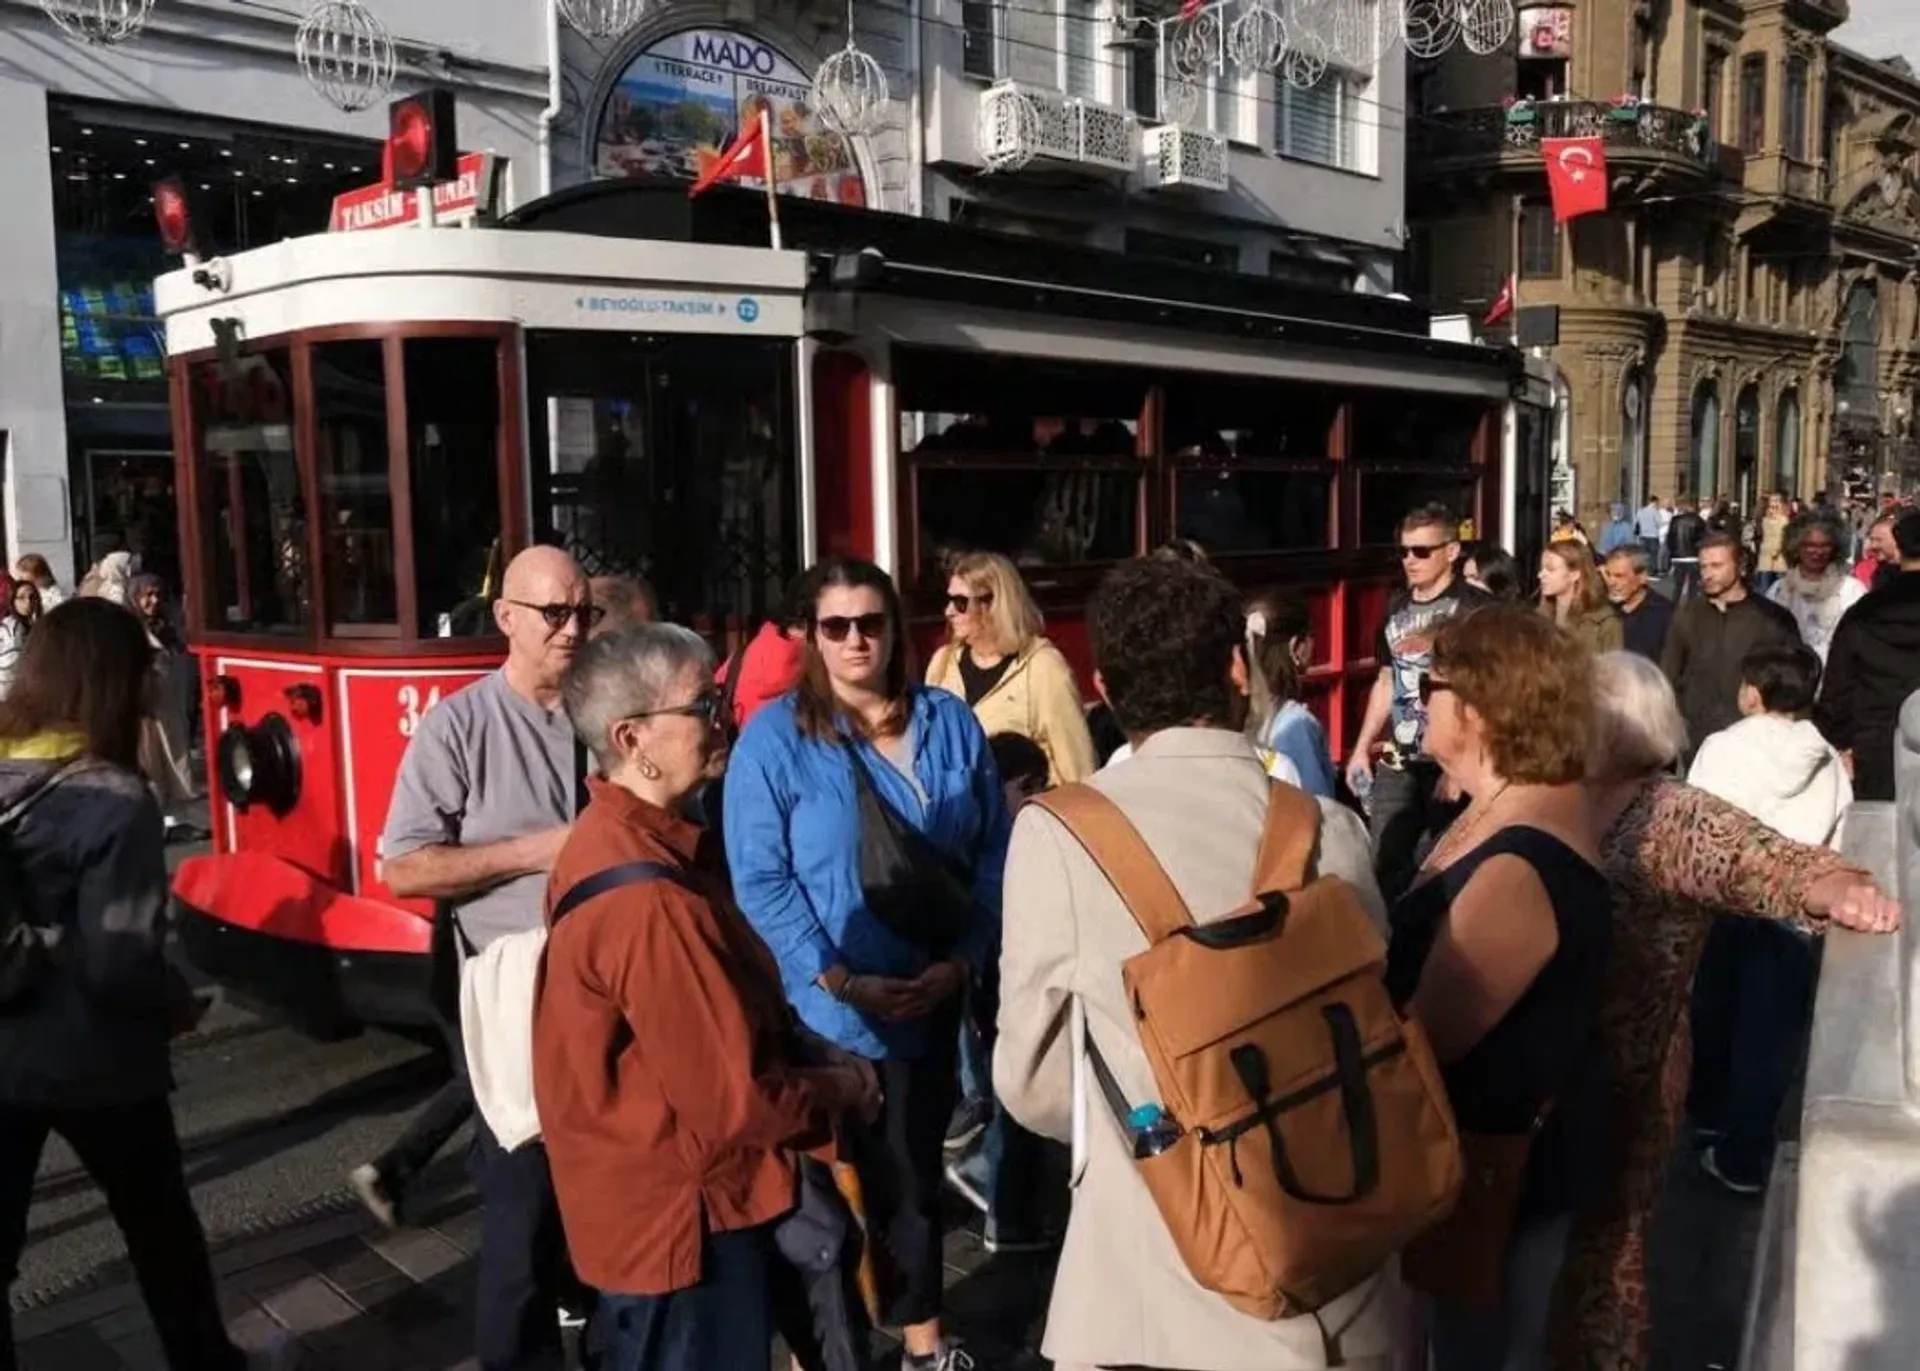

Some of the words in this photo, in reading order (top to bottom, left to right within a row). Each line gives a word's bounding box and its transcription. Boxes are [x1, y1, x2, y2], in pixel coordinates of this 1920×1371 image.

[693, 35, 775, 75] MADO
[663, 62, 716, 83] TERRACE
[746, 79, 807, 101] BREAKFAST
